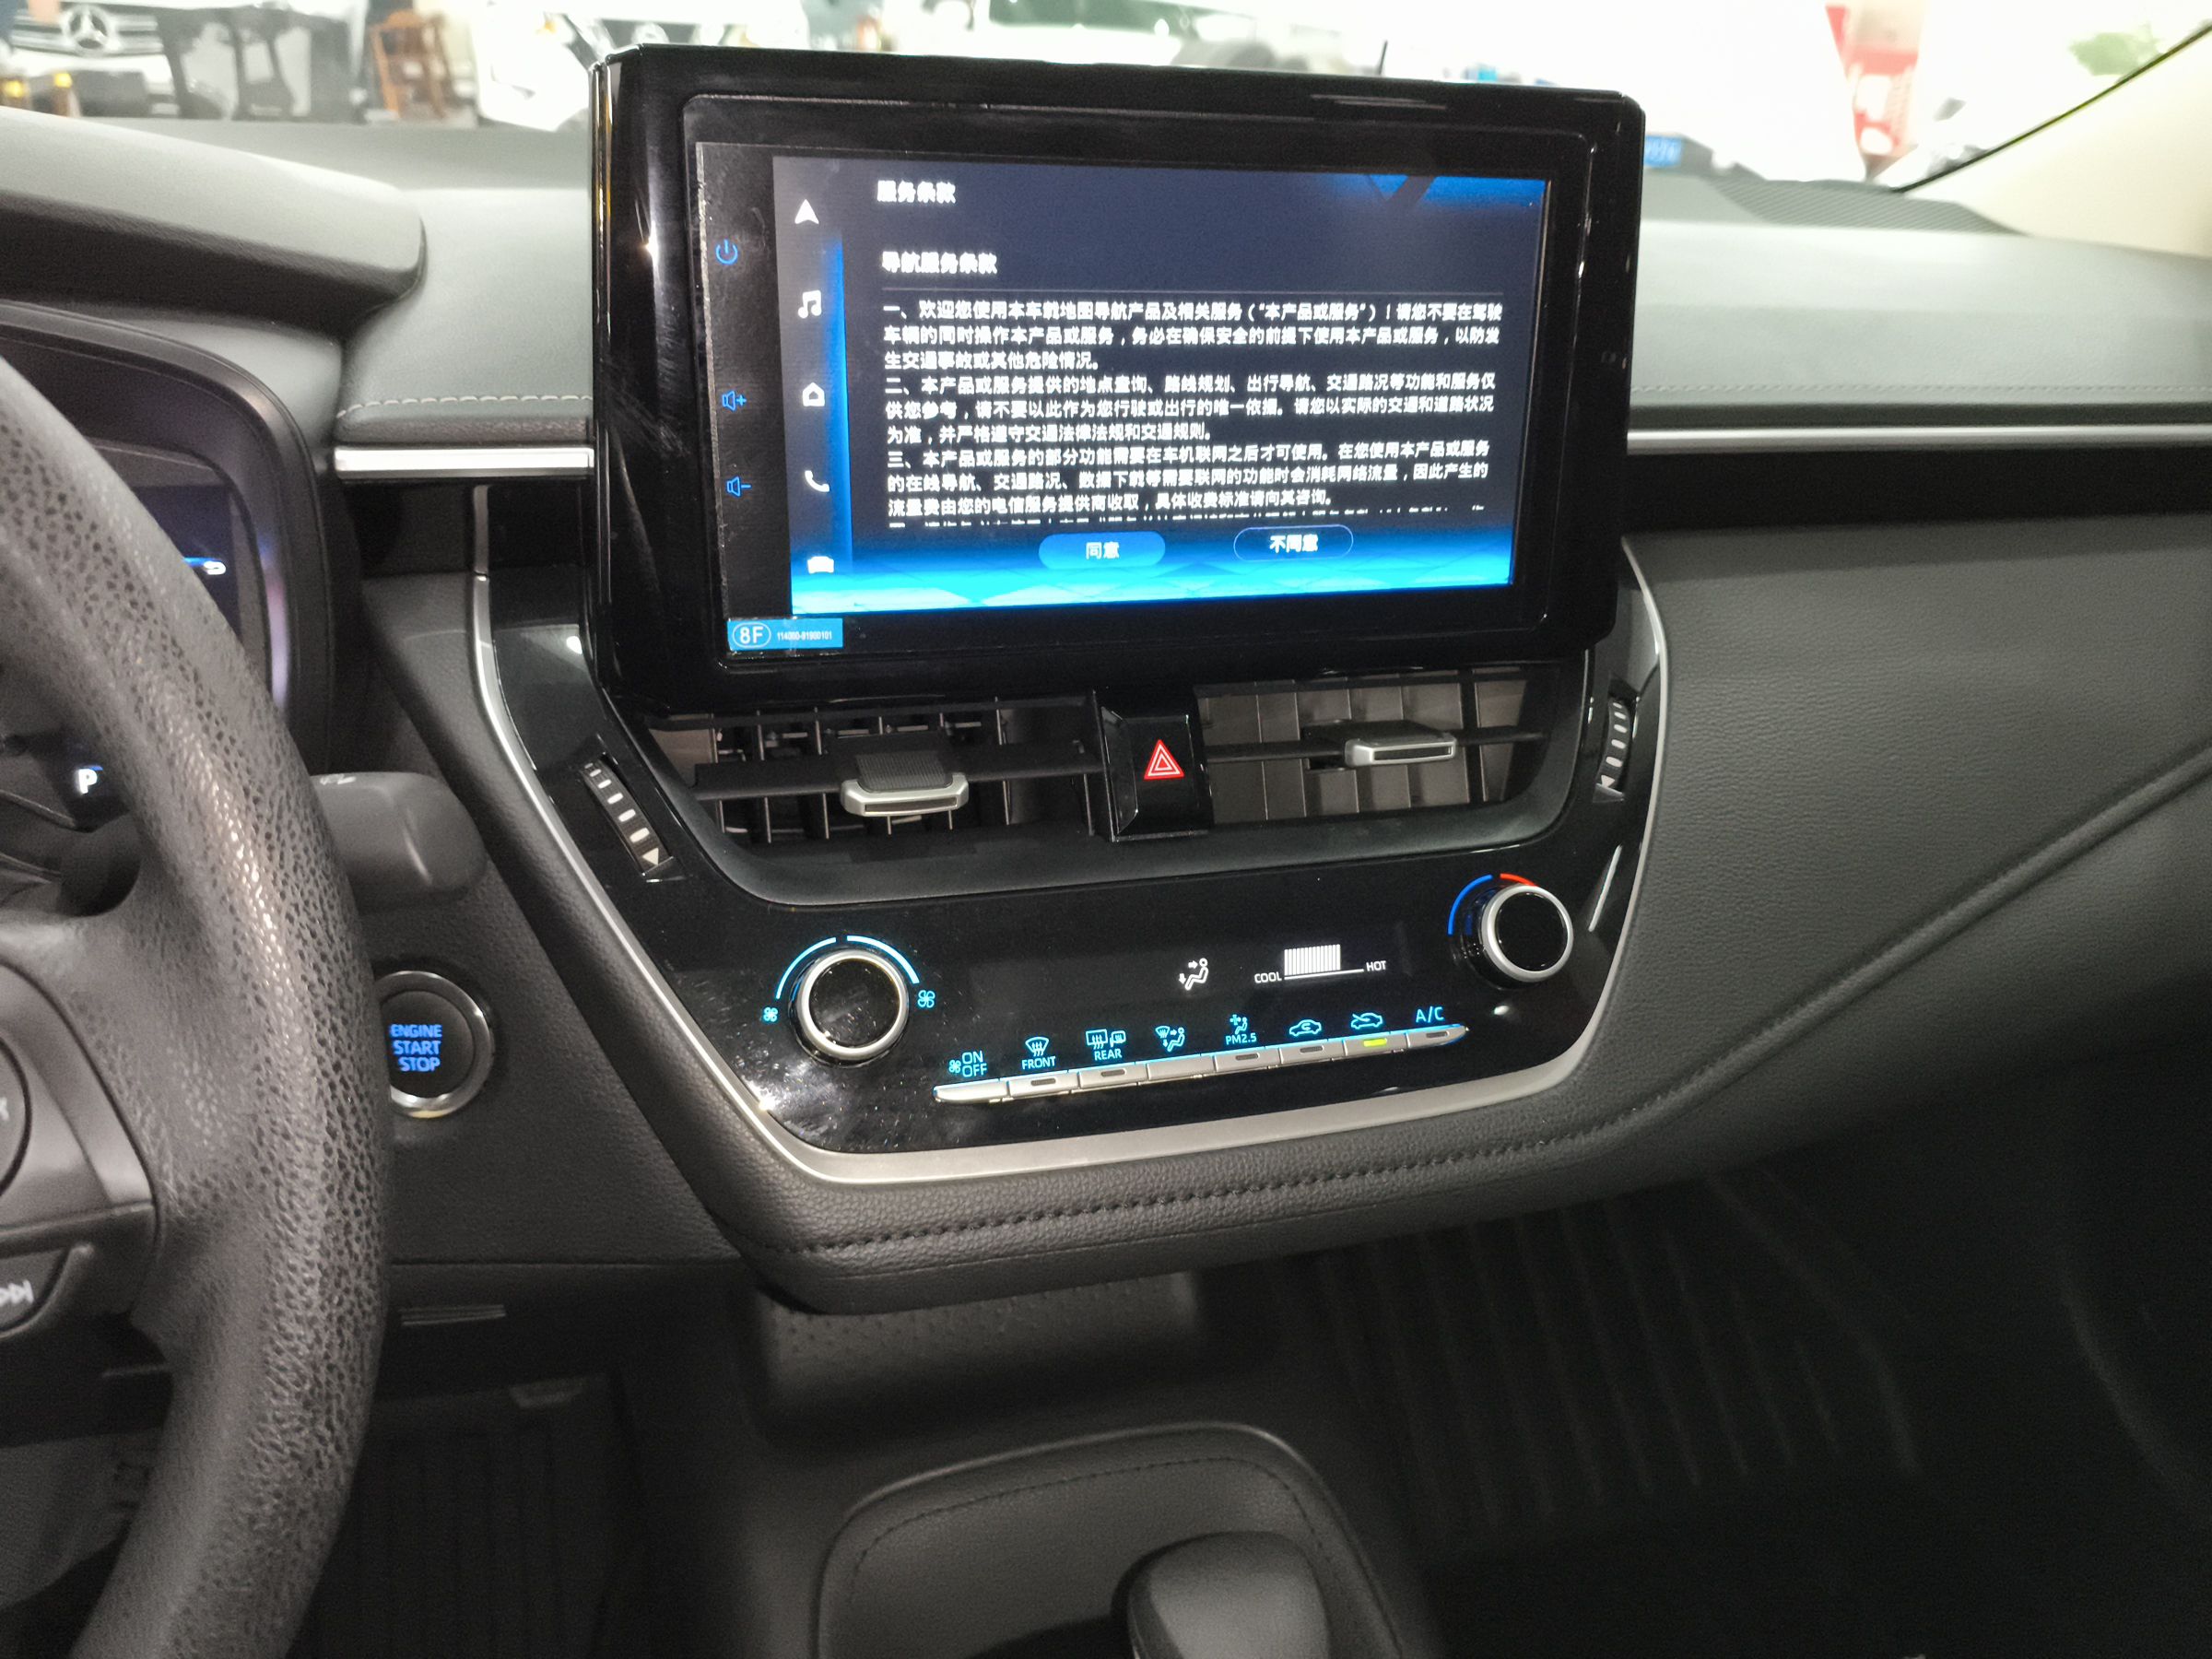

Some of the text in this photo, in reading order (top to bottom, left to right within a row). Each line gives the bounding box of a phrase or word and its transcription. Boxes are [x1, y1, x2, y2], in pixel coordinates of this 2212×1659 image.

[877, 180, 957, 204] 服务条款
[881, 251, 998, 275] 导航服务条款
[1086, 541, 1120, 559] 同意
[1269, 534, 1319, 554] 不同意
[739, 626, 764, 644] 8F
[1366, 960, 1386, 971] HOT
[1254, 971, 1282, 983] COOL
[1416, 1006, 1444, 1023] A/C
[390, 1024, 442, 1038] ENGINE
[1225, 1033, 1257, 1045] PM2.5
[393, 1040, 441, 1055] START
[1094, 1048, 1122, 1061] REAR
[397, 1056, 441, 1072] STOP
[961, 1050, 983, 1064] ON
[1021, 1055, 1056, 1070] FRONT
[961, 1064, 988, 1077] OFF
